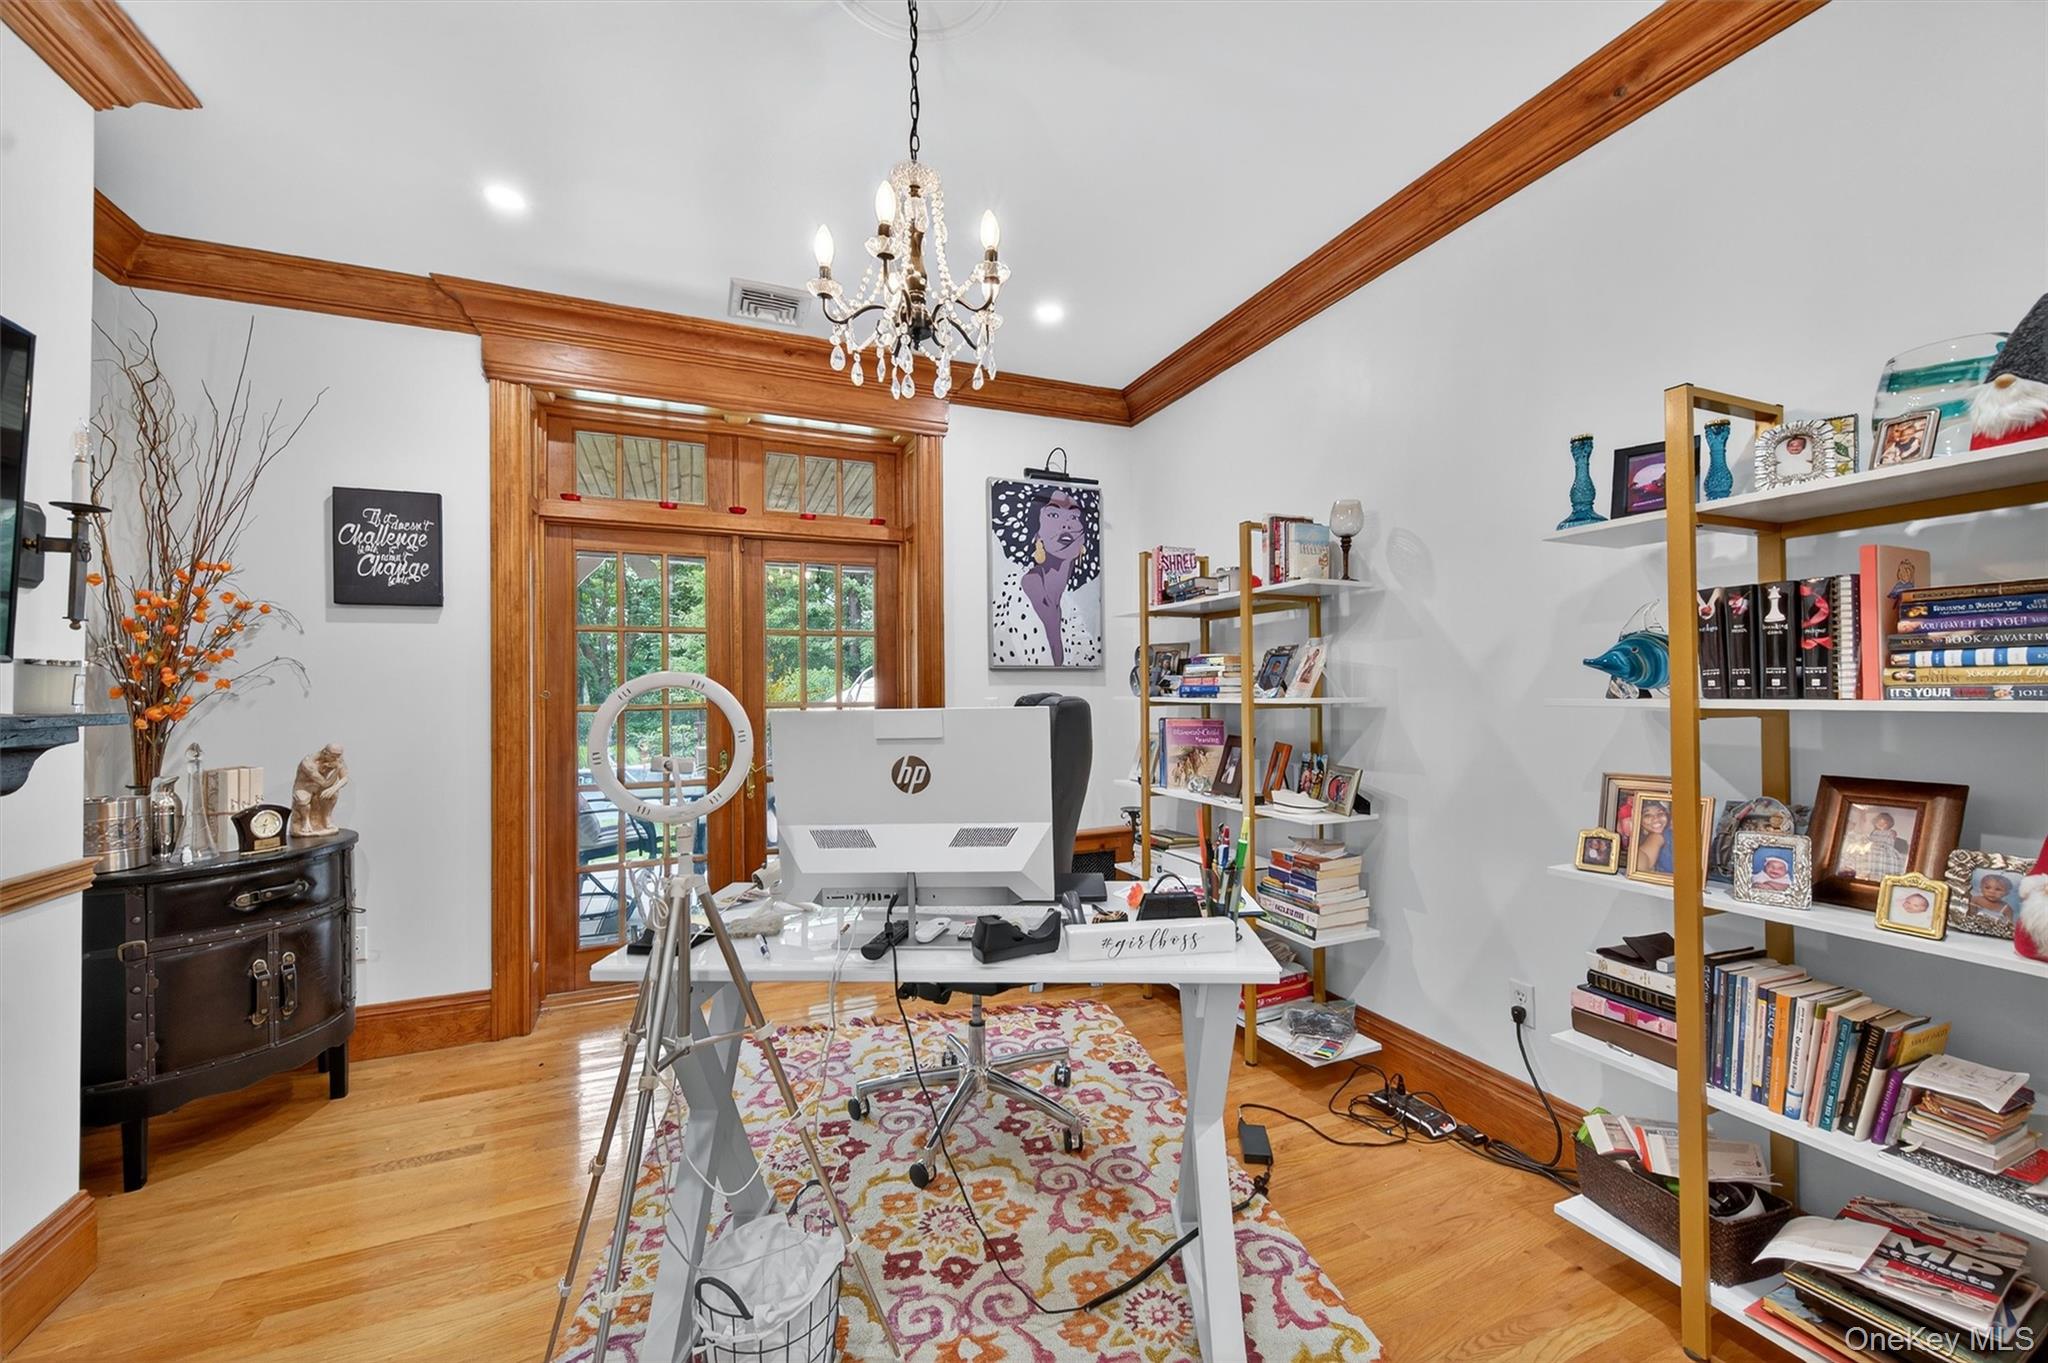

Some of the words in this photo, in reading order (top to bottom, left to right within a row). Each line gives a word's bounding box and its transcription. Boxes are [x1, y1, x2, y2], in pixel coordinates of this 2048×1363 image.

[338, 522, 429, 552] Challenge
[357, 553, 430, 582] Change
[1161, 553, 1197, 573] SHRED
[1945, 634, 1981, 645] BOOK
[1890, 687, 1912, 698] IT'S
[1914, 687, 1951, 697] YOUR
[1101, 928, 1205, 959] #girlboss
